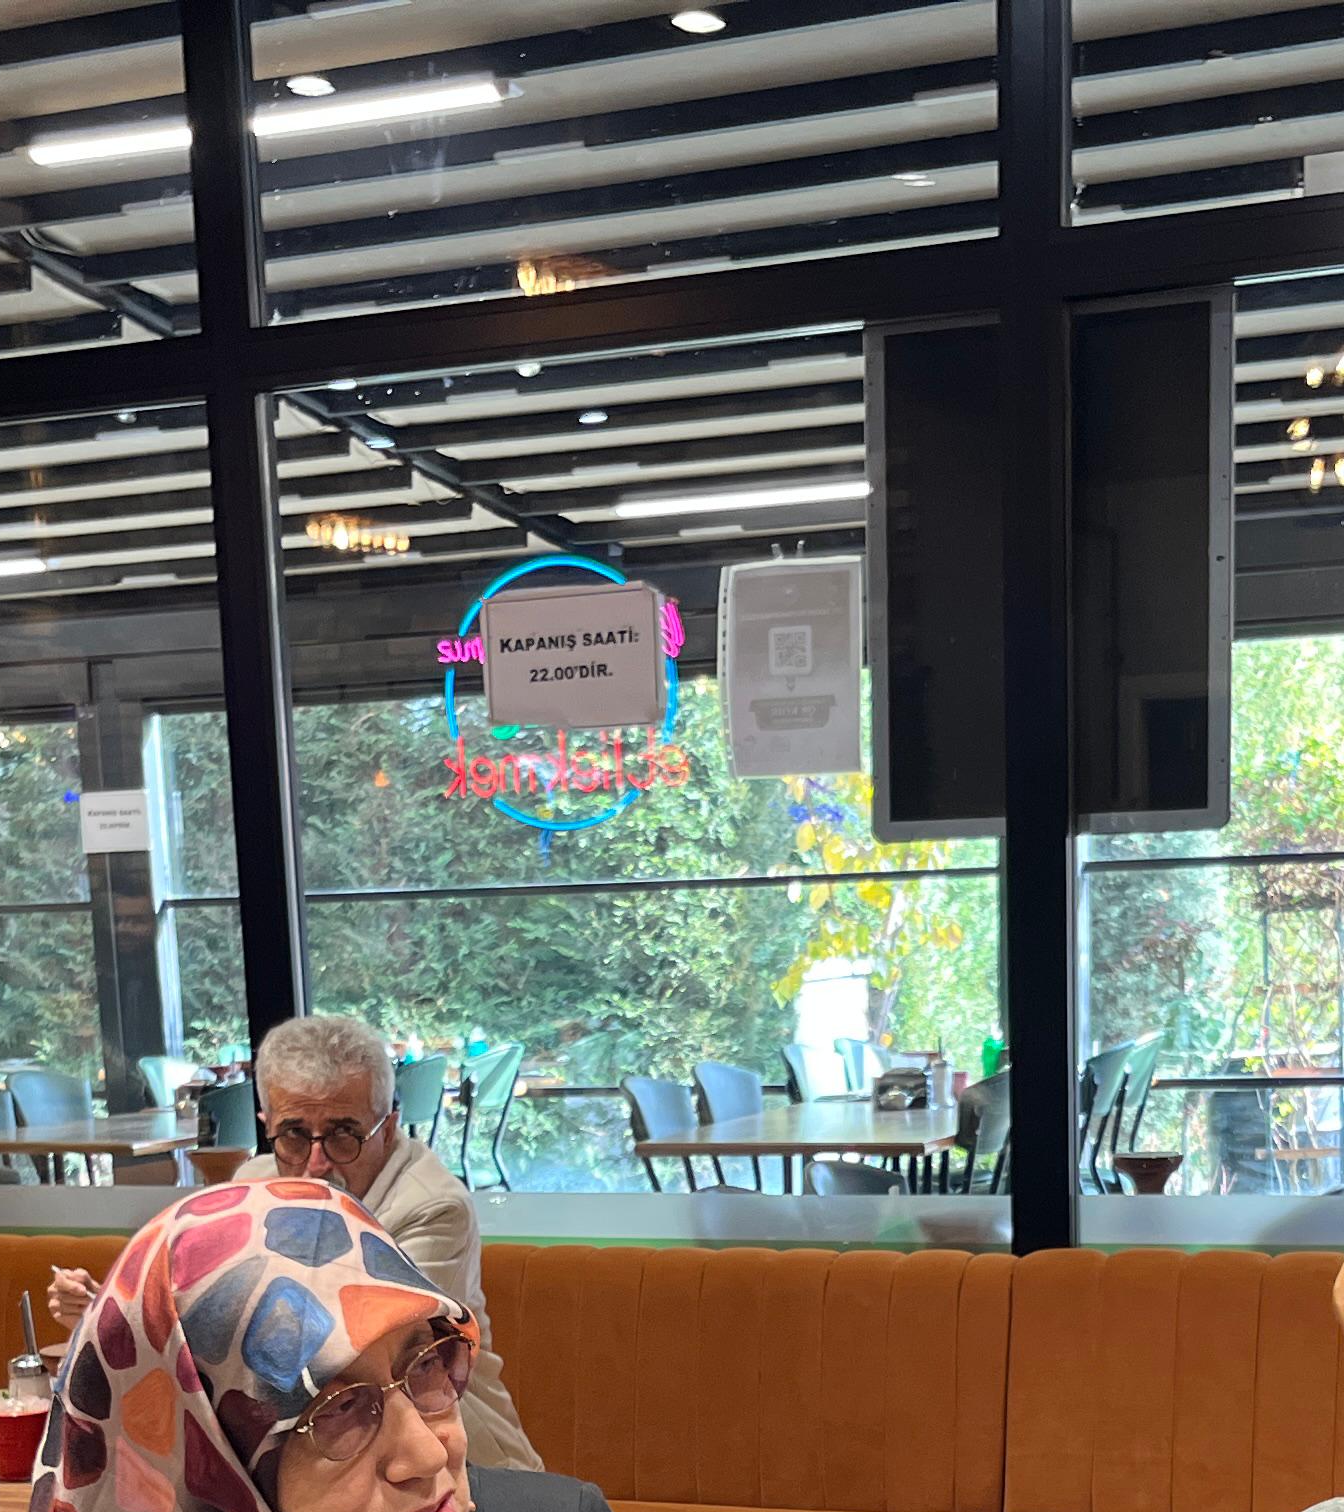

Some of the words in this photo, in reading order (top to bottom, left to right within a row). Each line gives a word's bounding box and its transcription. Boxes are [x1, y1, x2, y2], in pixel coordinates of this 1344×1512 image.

[499, 634, 577, 653] KAPANIŞ
[582, 626, 640, 647] SAATİ:
[529, 661, 614, 683] 22.00'DİR.
